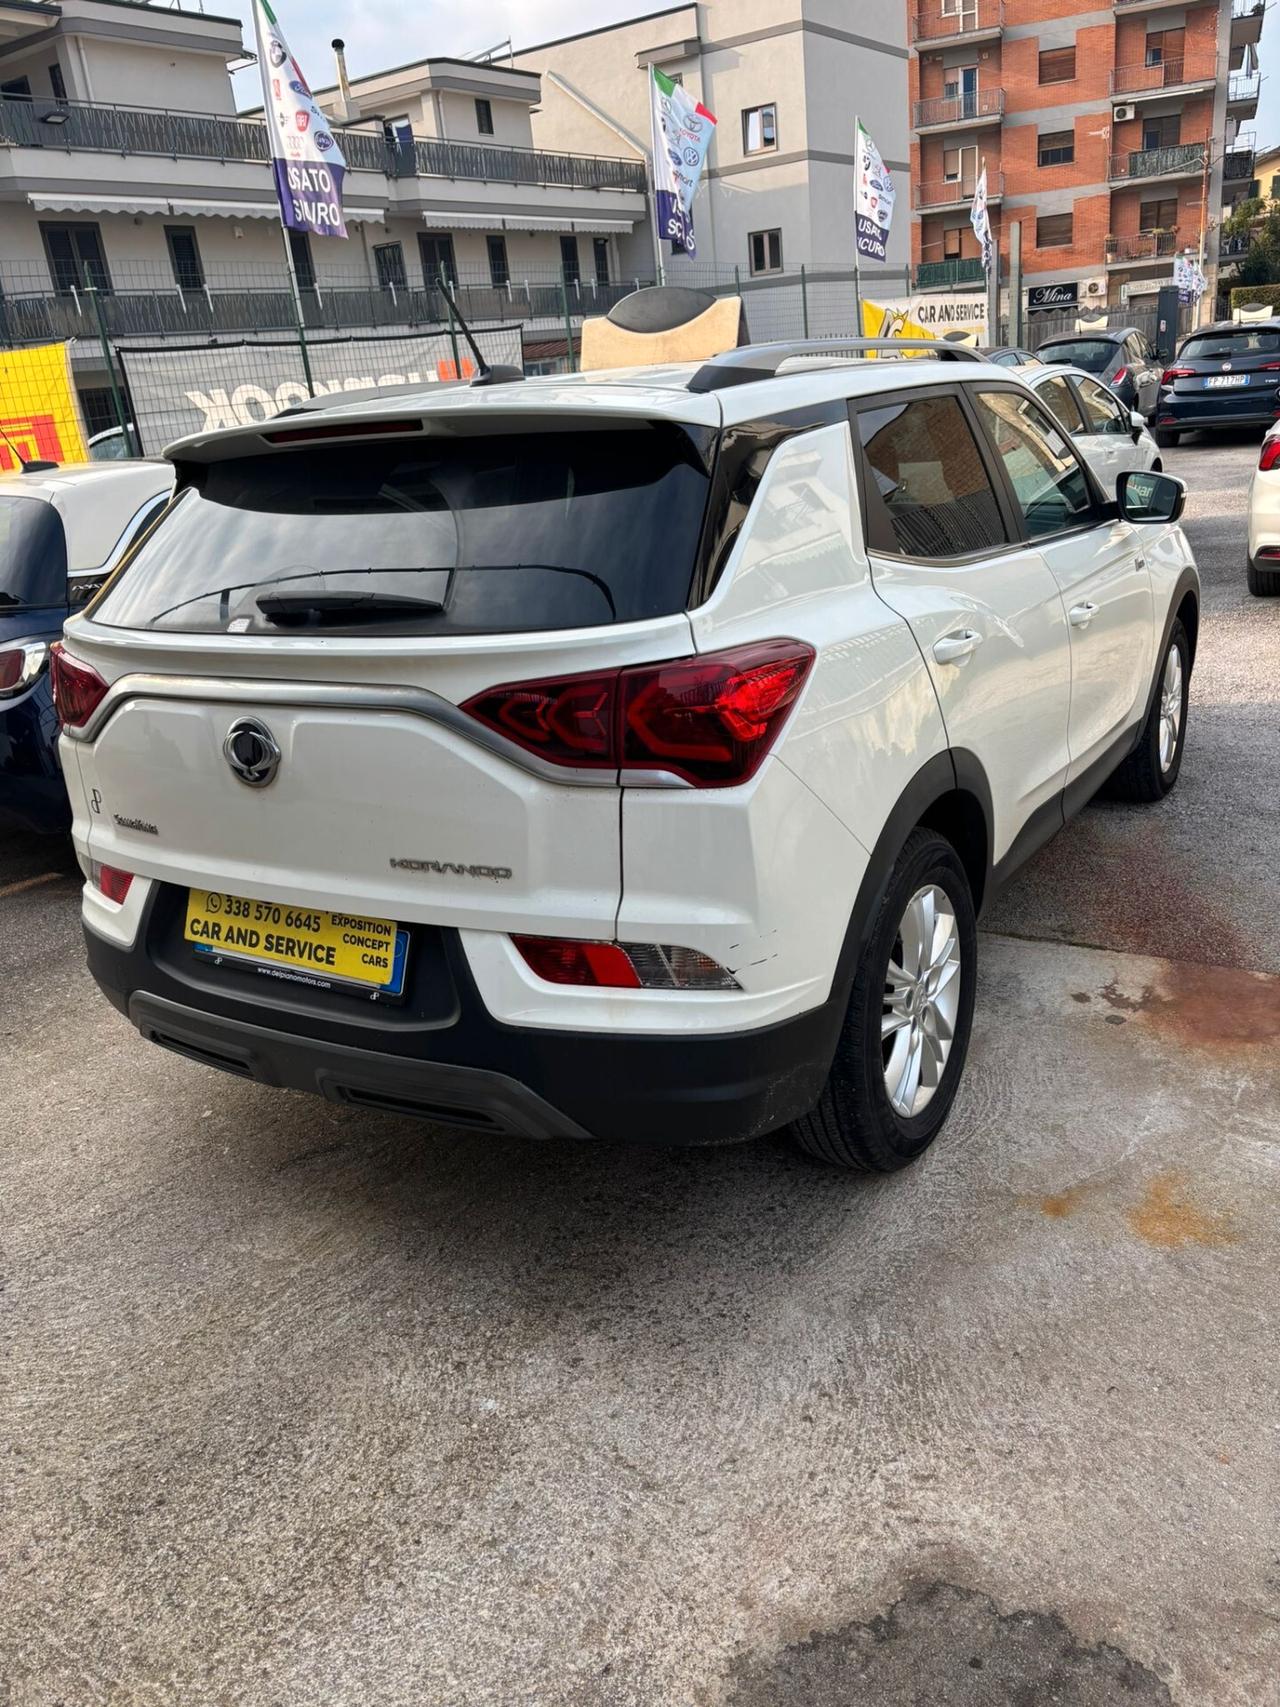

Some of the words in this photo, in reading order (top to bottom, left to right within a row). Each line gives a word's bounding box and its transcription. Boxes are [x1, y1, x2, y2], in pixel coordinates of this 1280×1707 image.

[1033, 286, 1073, 304] Mina
[918, 305, 936, 323] CAR
[938, 304, 954, 321] AND
[956, 303, 984, 320] SERVICE
[389, 858, 512, 880] KORANDO
[223, 899, 251, 918] 338
[254, 906, 281, 924] 570
[285, 911, 321, 933] 6645
[331, 914, 392, 936] EXPOSITION
[190, 918, 221, 941] CAR
[224, 926, 260, 948] AND
[264, 934, 336, 966] SERVICE
[342, 933, 391, 952] CONCEPT
[361, 953, 389, 968] CARS
[257, 966, 331, 989] www.delpianomotors.com
